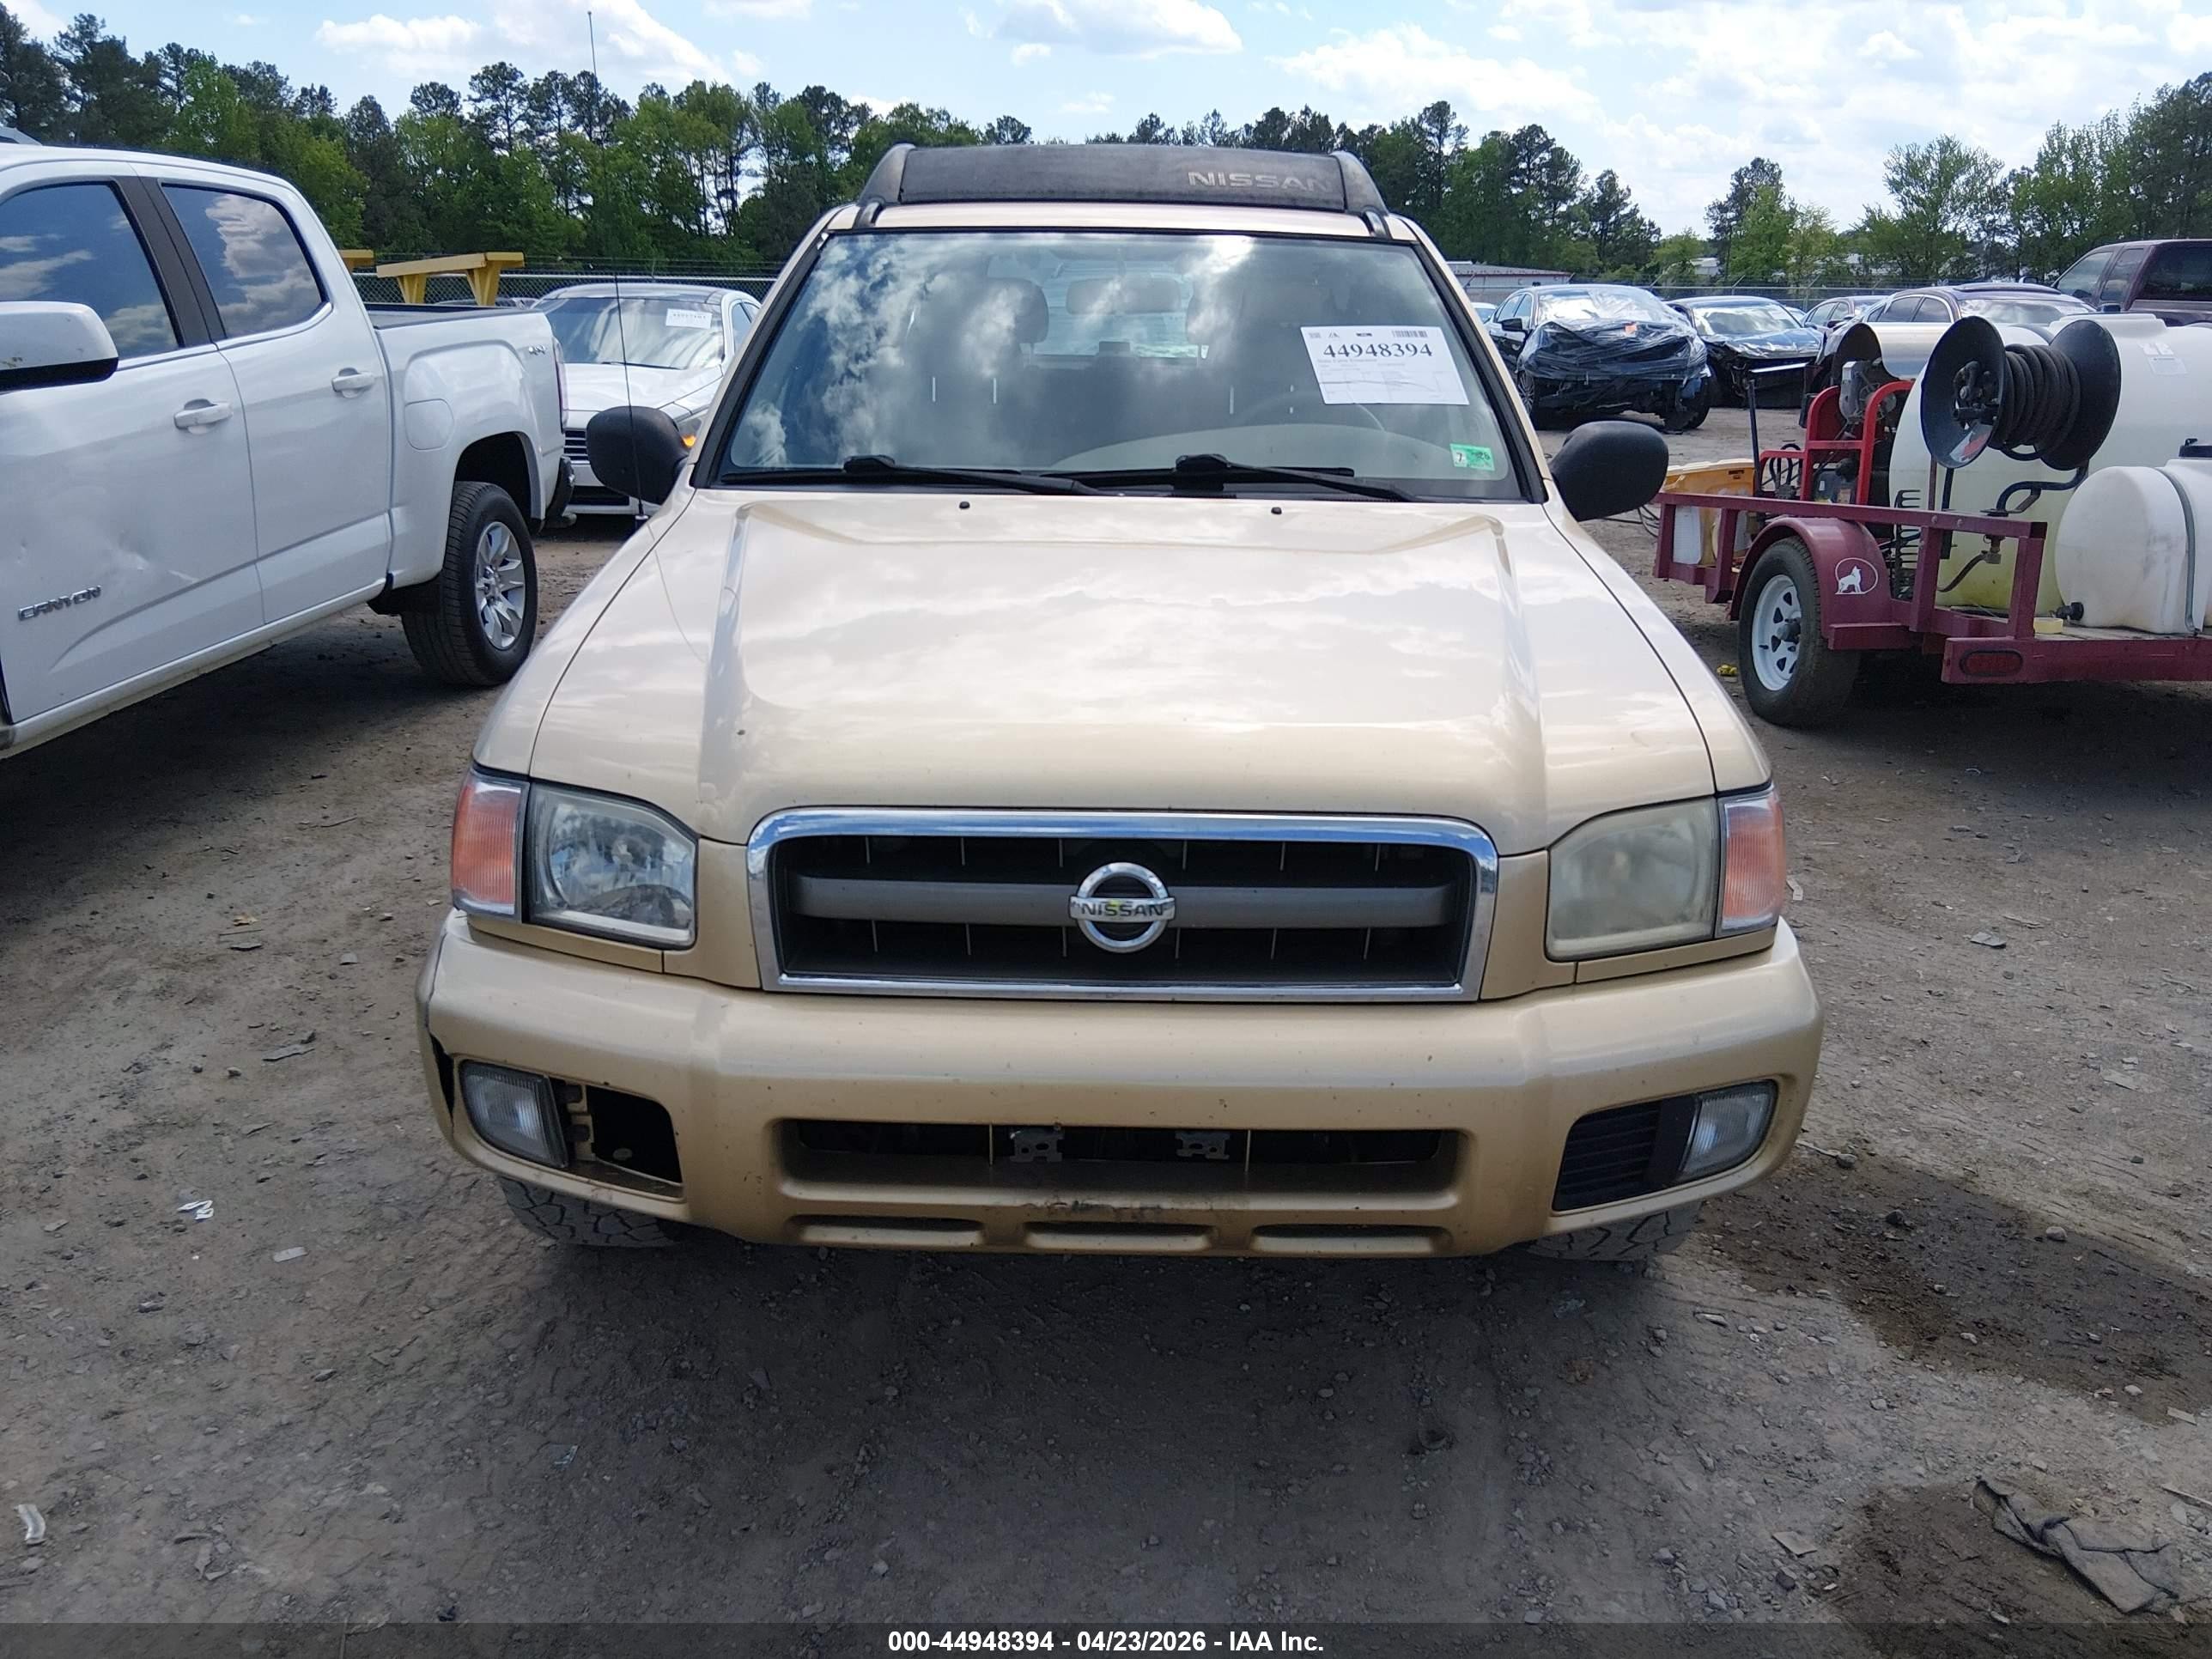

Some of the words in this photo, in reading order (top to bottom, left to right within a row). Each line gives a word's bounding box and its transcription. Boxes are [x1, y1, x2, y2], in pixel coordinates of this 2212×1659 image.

[1188, 171, 1331, 192] NISSAN
[1323, 343, 1433, 358] 44948394
[18, 585, 101, 621] CANYON
[1081, 902, 1164, 917] NISSAN
